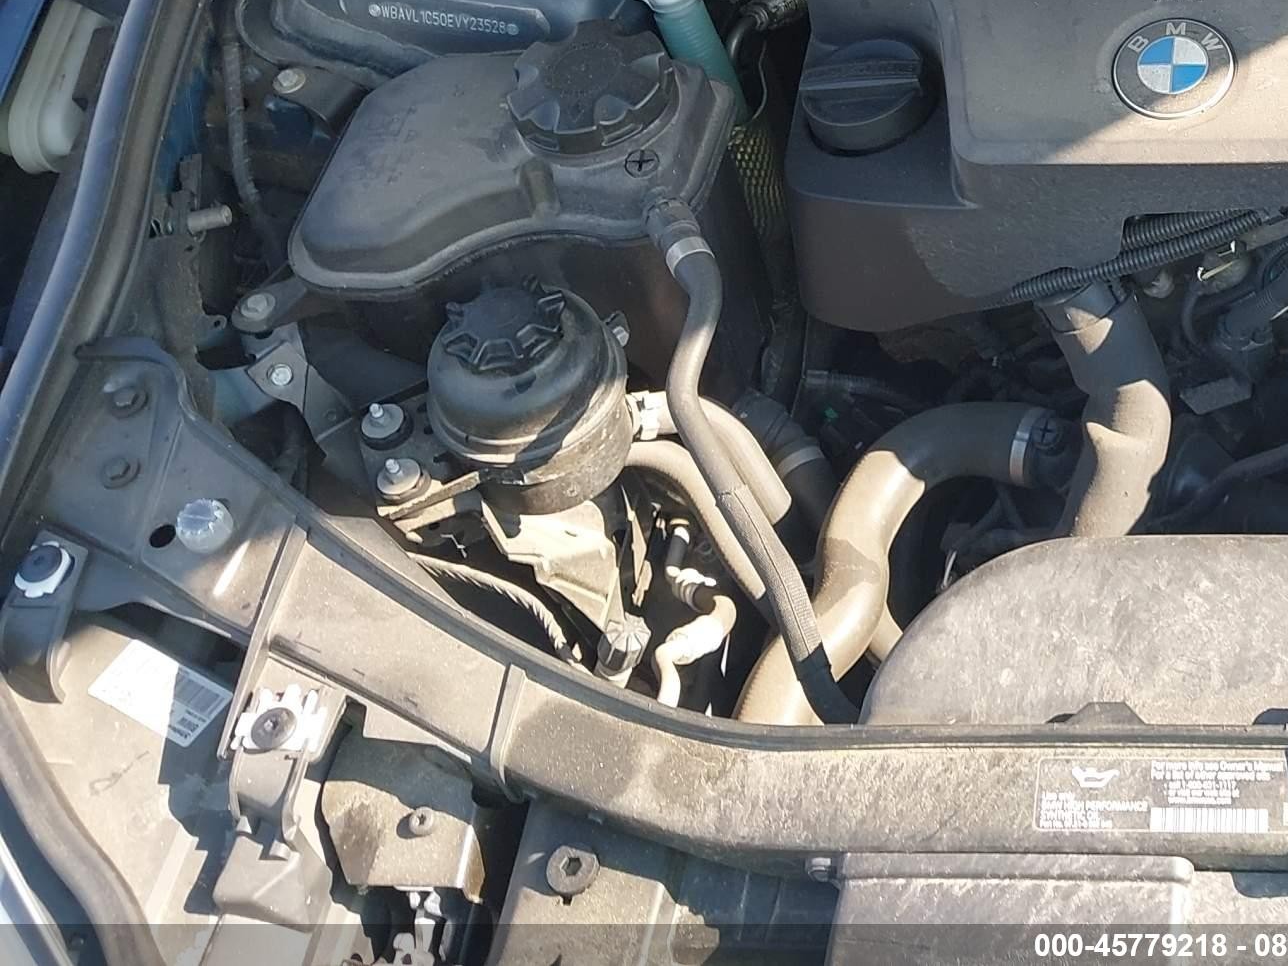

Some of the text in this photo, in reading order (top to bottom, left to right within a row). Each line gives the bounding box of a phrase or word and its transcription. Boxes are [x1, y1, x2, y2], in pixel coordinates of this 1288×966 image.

[380, 4, 506, 35] WBAVL1C50EVY23528
[1127, 22, 1224, 52] BMW
[1040, 810, 1087, 821] SYNTHETIC
[1085, 800, 1148, 812] PERFORMANCE
